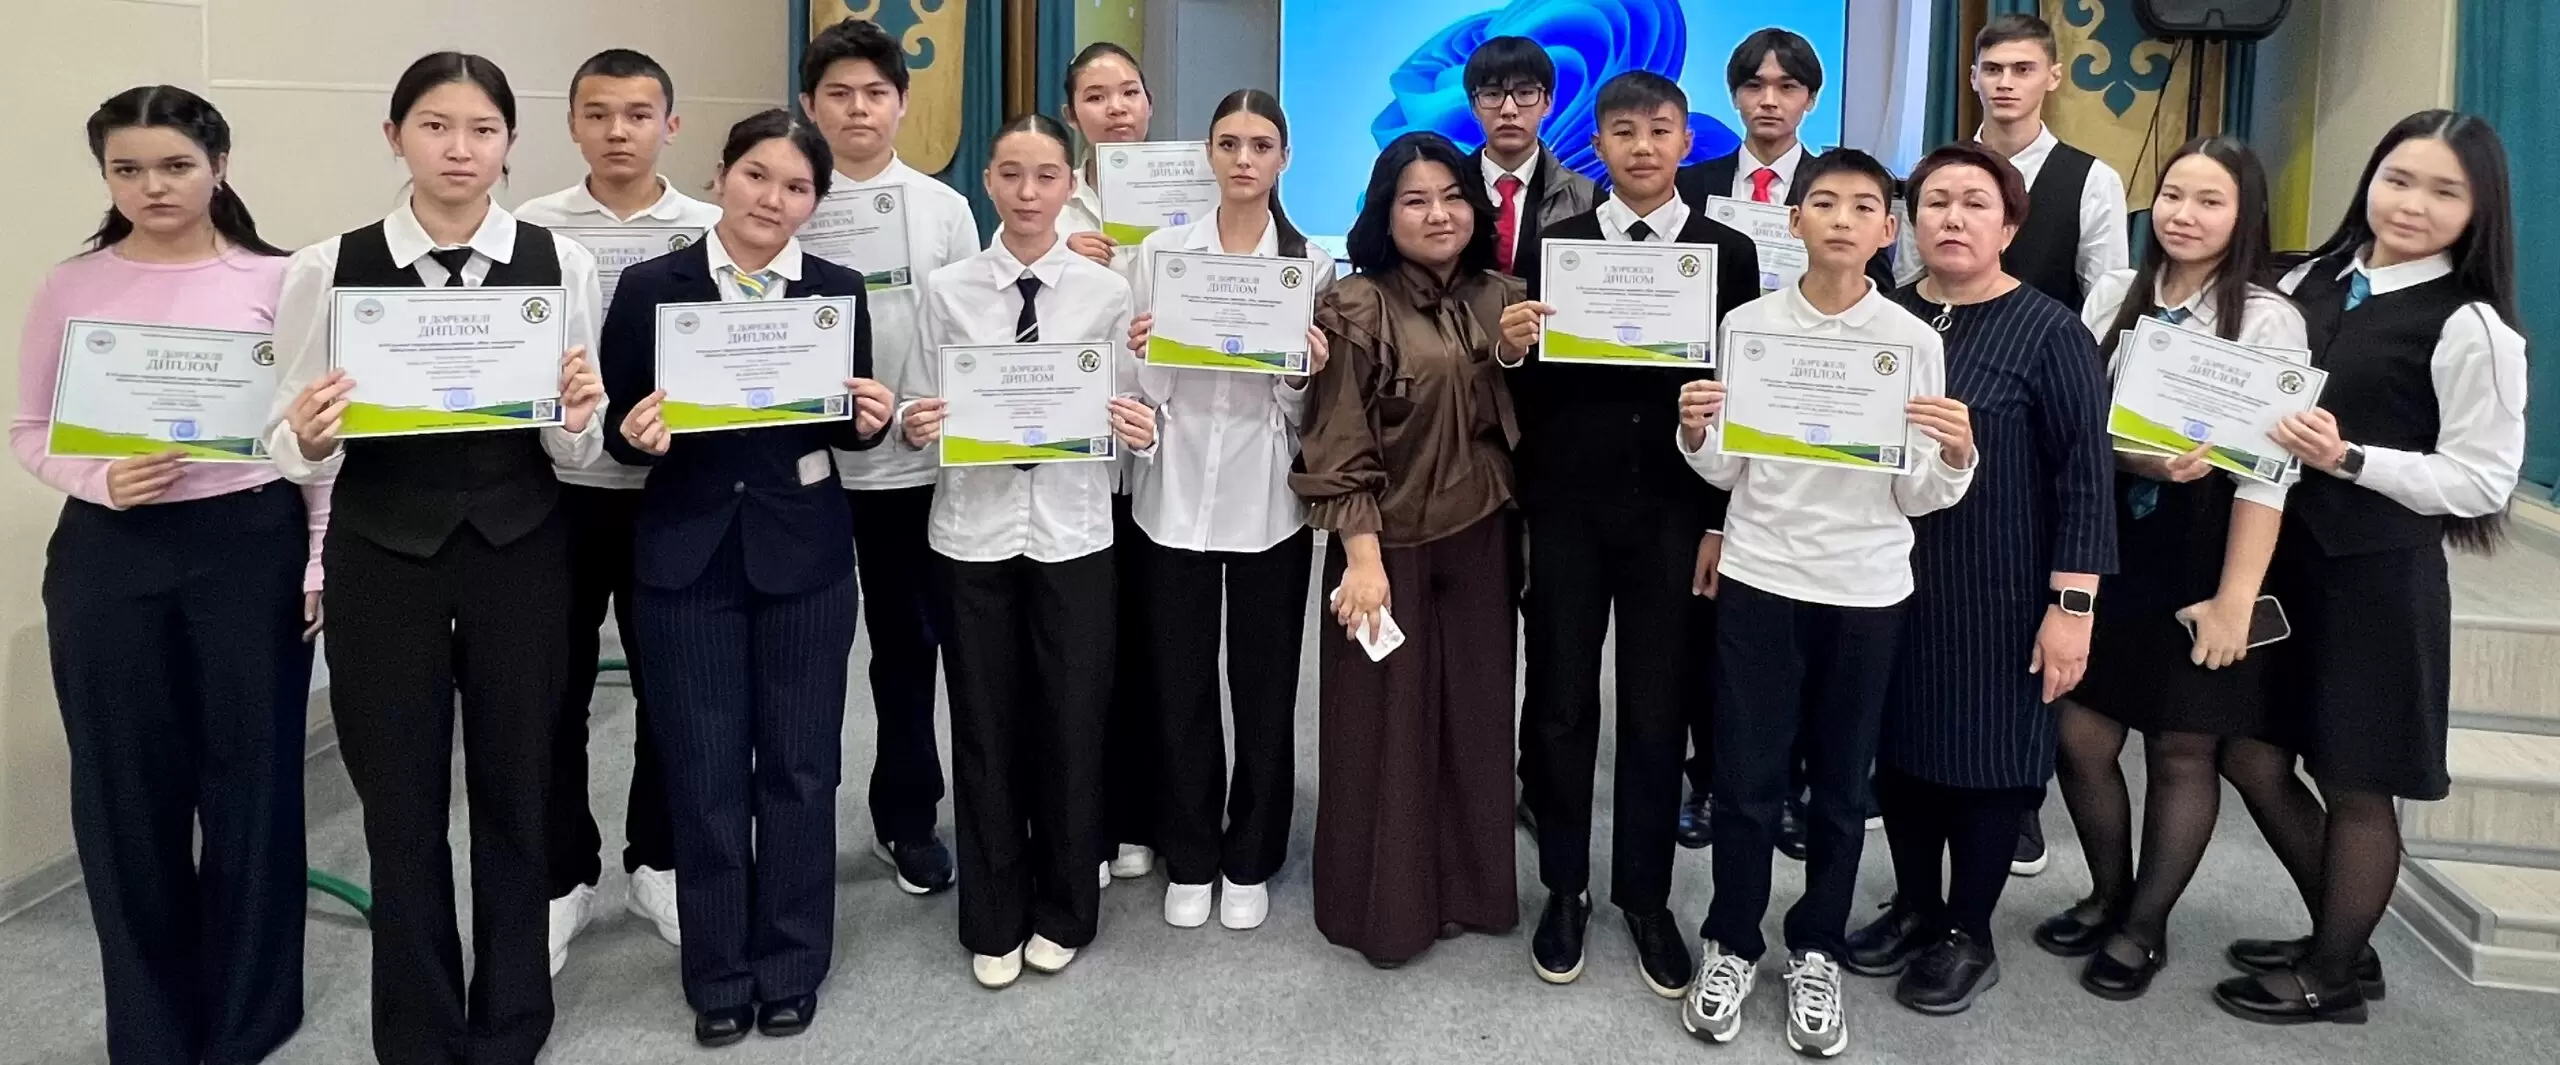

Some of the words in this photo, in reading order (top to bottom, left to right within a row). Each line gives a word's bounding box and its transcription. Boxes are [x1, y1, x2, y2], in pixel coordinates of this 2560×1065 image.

[1150, 167, 1194, 178] ДИПЛОМ
[596, 255, 644, 265] ИПЛОМ
[1602, 274, 1654, 285] ДИПЛОМ
[1206, 283, 1257, 295] ДИПЛОМ
[417, 324, 490, 339] ДИПЛОМ
[727, 331, 787, 345] ДИПЛОМ
[145, 359, 219, 373] ДИПЛОМ
[1000, 373, 1055, 385] ДИПЛОМ
[1789, 366, 1846, 381] ДИПЛОМ
[2187, 364, 2247, 388] ДИПЛОМ
